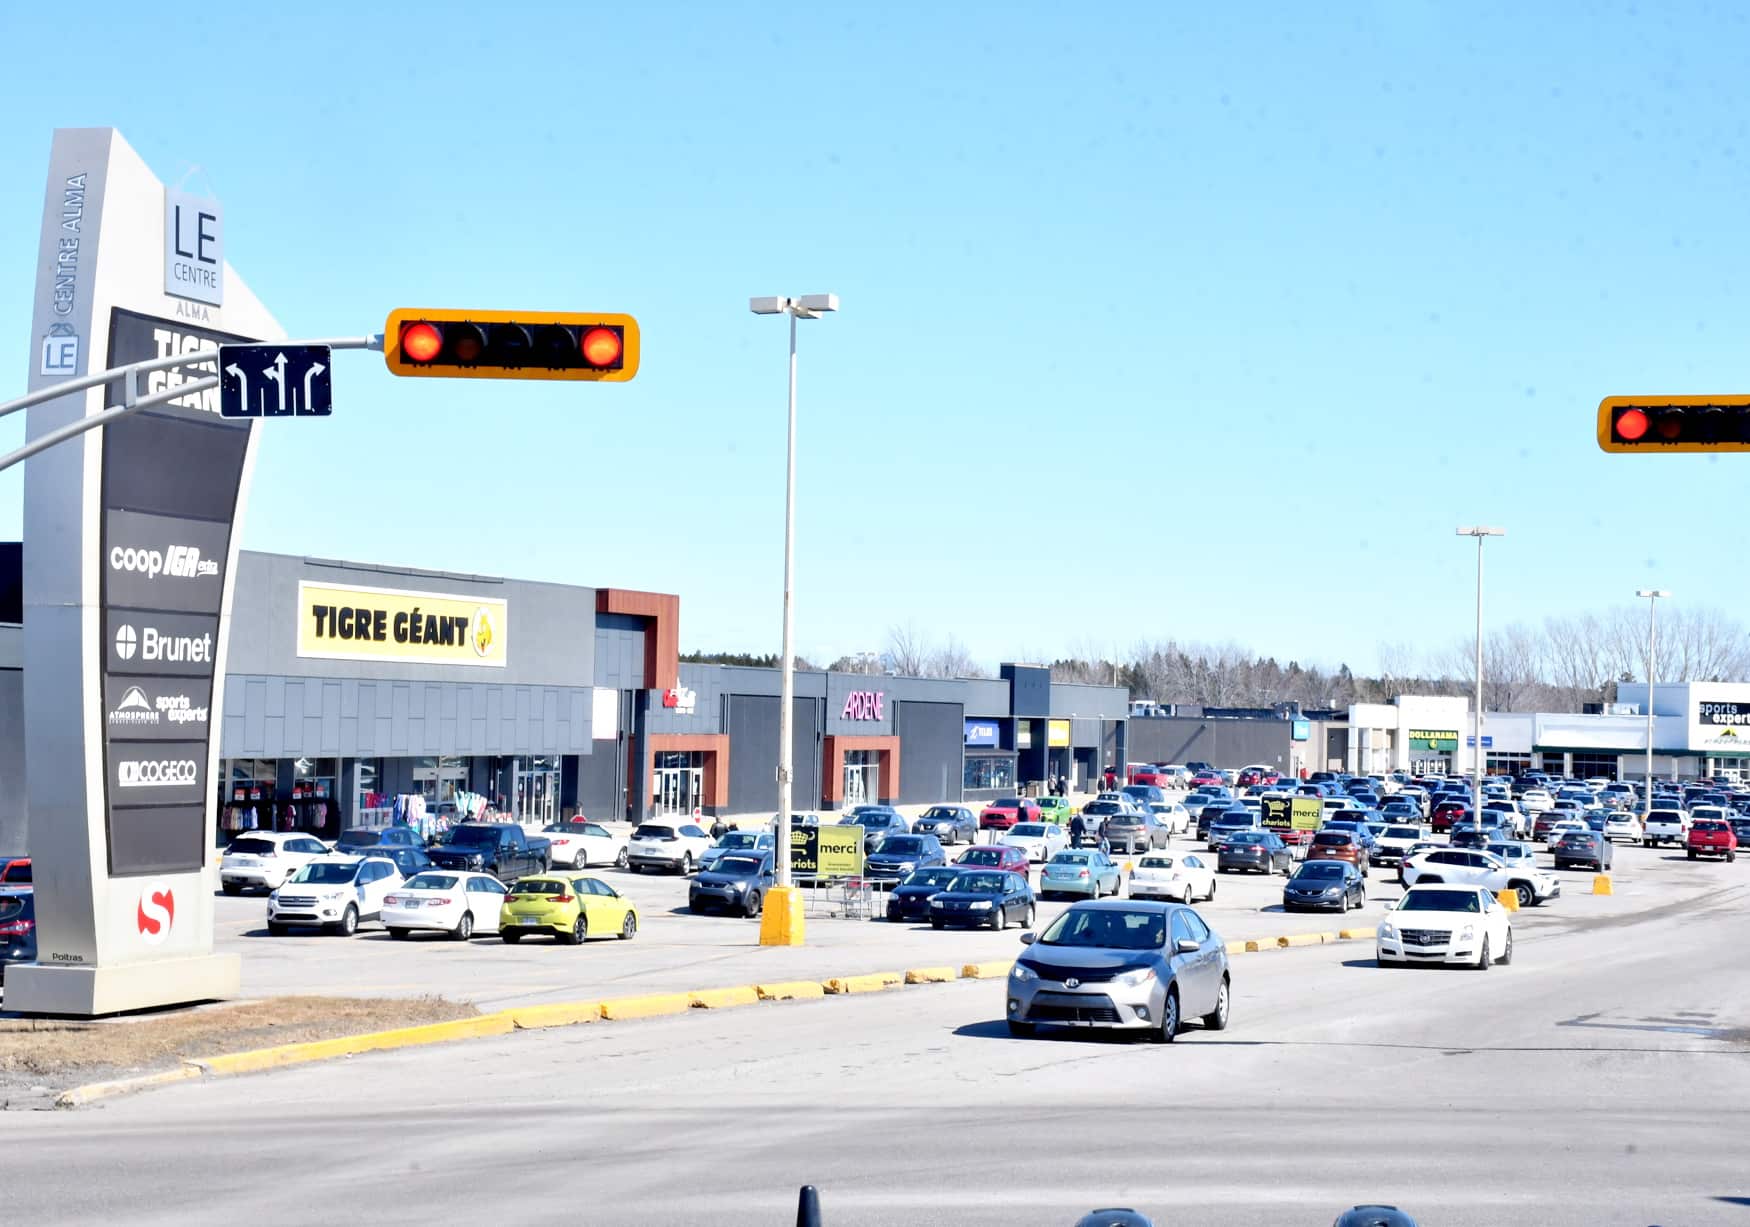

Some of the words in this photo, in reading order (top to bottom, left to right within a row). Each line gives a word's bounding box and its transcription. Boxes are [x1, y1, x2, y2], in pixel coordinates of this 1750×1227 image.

[62, 172, 87, 233] ALMA
[175, 205, 216, 264] LE
[54, 237, 80, 317] CENTRE
[174, 262, 217, 289] CENTRE
[176, 302, 210, 322] ALMA
[45, 343, 75, 369] LE
[154, 328, 218, 373] TIGR
[110, 546, 162, 579] coop
[162, 545, 200, 577] IGA
[312, 604, 387, 641] TIGRE
[393, 607, 469, 646] GÉANT
[142, 627, 212, 662] Brunet
[156, 694, 190, 712] sports
[841, 690, 884, 720] ARDENE
[1700, 704, 1737, 716] sports
[1409, 731, 1457, 739] DOLLARAMA
[138, 760, 197, 781] COGECO
[1263, 818, 1290, 827] chariots
[1293, 809, 1320, 817] merci
[820, 841, 857, 854] merci
